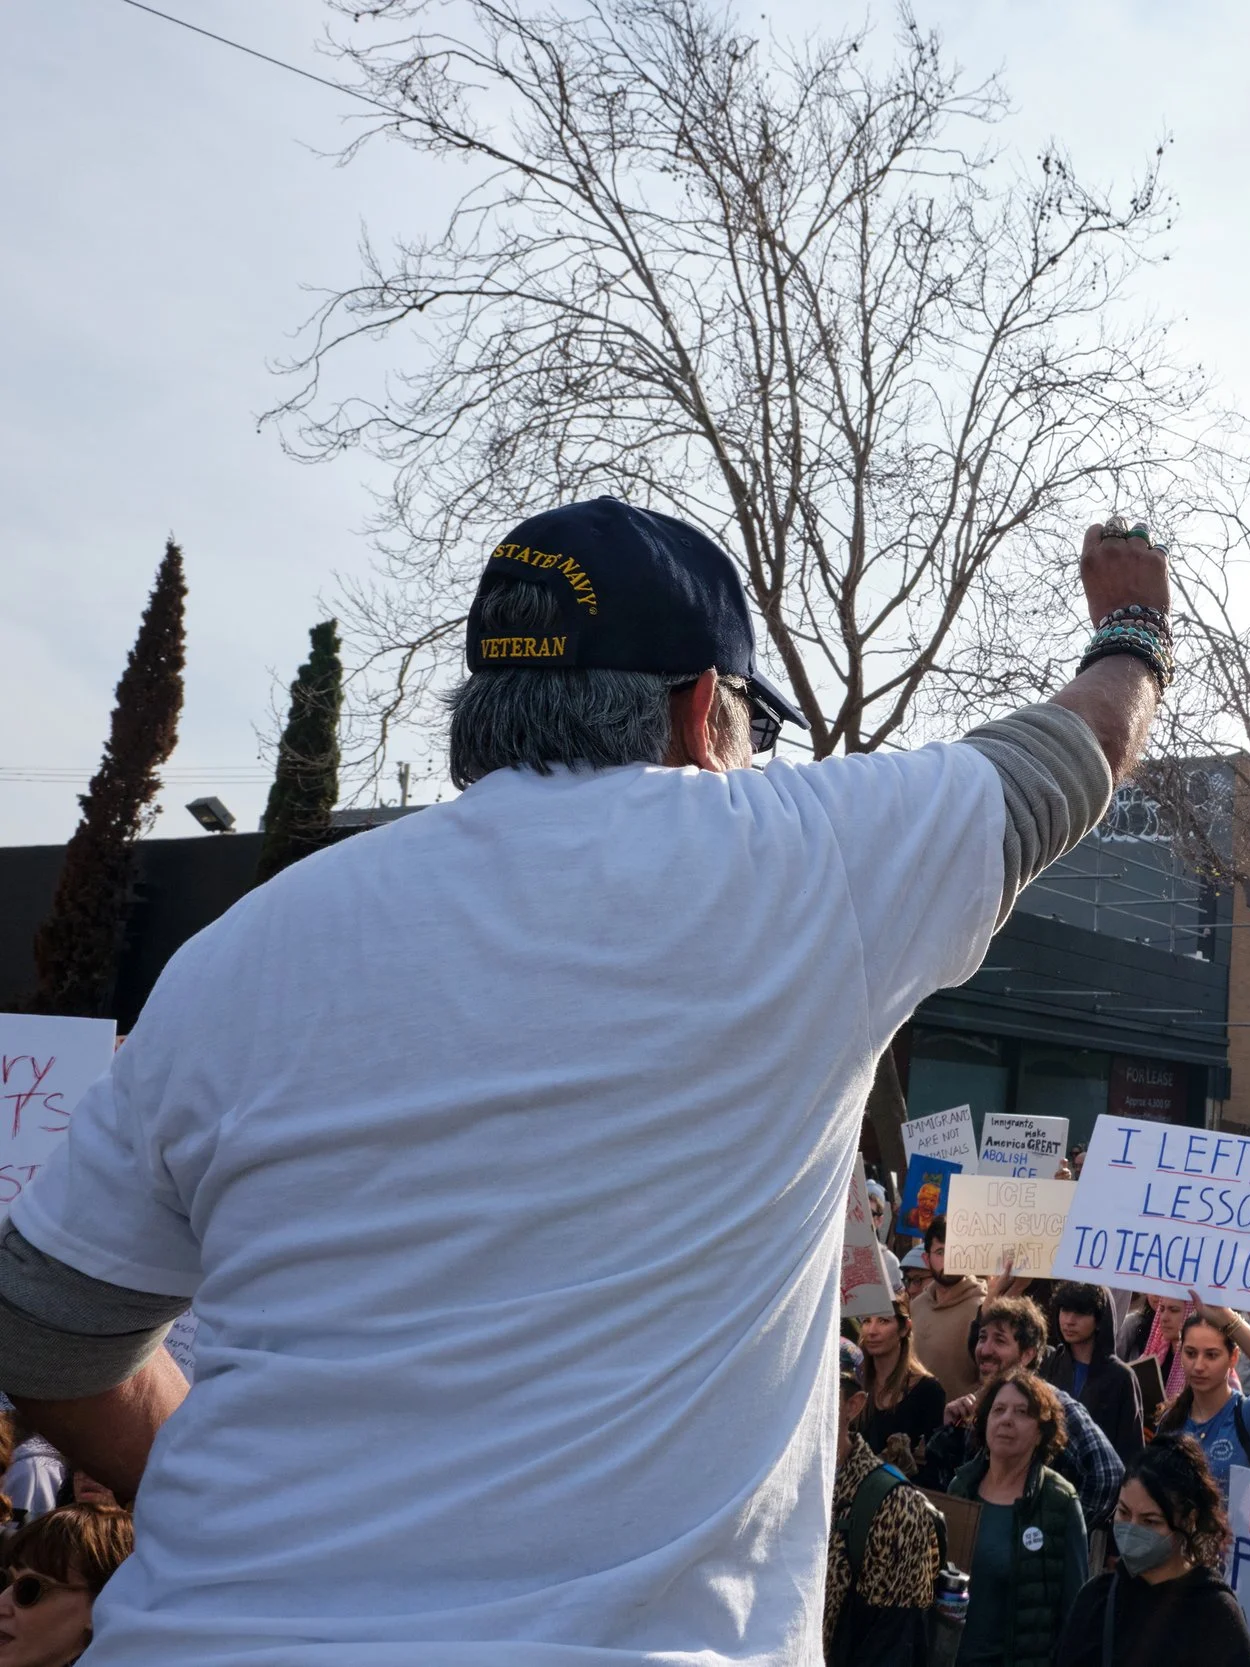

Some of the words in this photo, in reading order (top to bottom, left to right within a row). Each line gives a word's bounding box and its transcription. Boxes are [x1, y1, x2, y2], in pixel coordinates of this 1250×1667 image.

[557, 557, 598, 606] NAVY
[481, 636, 567, 659] VETERAN
[1126, 1066, 1144, 1084] FOR
[1146, 1067, 1174, 1087] LEASE
[906, 1109, 970, 1138] IMMIGRANTS
[918, 1134, 938, 1150] ARE
[943, 1128, 960, 1142] NOT
[1027, 1138, 1061, 1155] GREAT
[1111, 1128, 1141, 1165] I
[982, 1149, 1028, 1165] ABOLISH
[1012, 1167, 1038, 1178] ICE
[988, 1181, 1037, 1208] ICE
[951, 1209, 1006, 1237] CAN
[1015, 1212, 1065, 1237] SUC
[950, 1243, 993, 1270] MY
[1075, 1226, 1108, 1268] TO
[1115, 1229, 1206, 1283] TEACH
[1213, 1240, 1238, 1286] U
